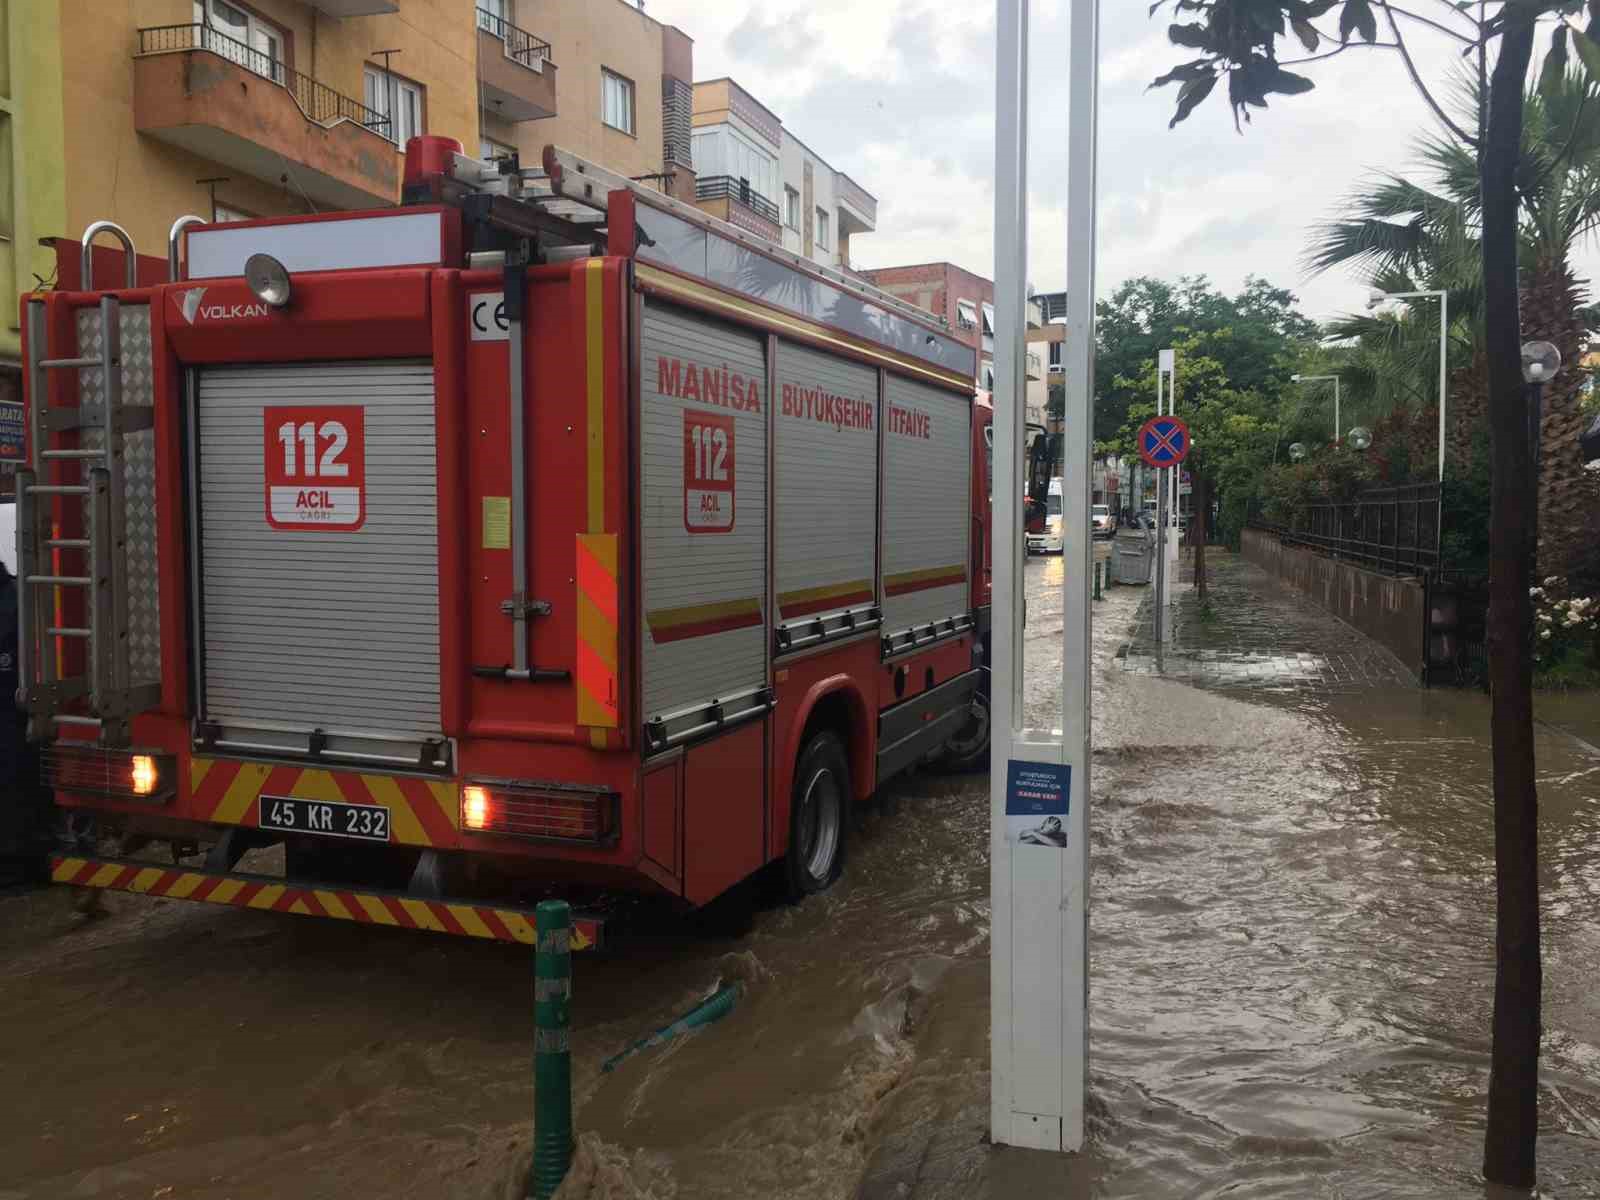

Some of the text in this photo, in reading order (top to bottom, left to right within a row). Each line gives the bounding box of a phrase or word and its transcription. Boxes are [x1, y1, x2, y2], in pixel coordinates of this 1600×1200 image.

[200, 303, 268, 319] VOLKAN
[278, 420, 349, 477] 112
[692, 424, 728, 480] 112
[271, 801, 386, 836] 45 KR 232
